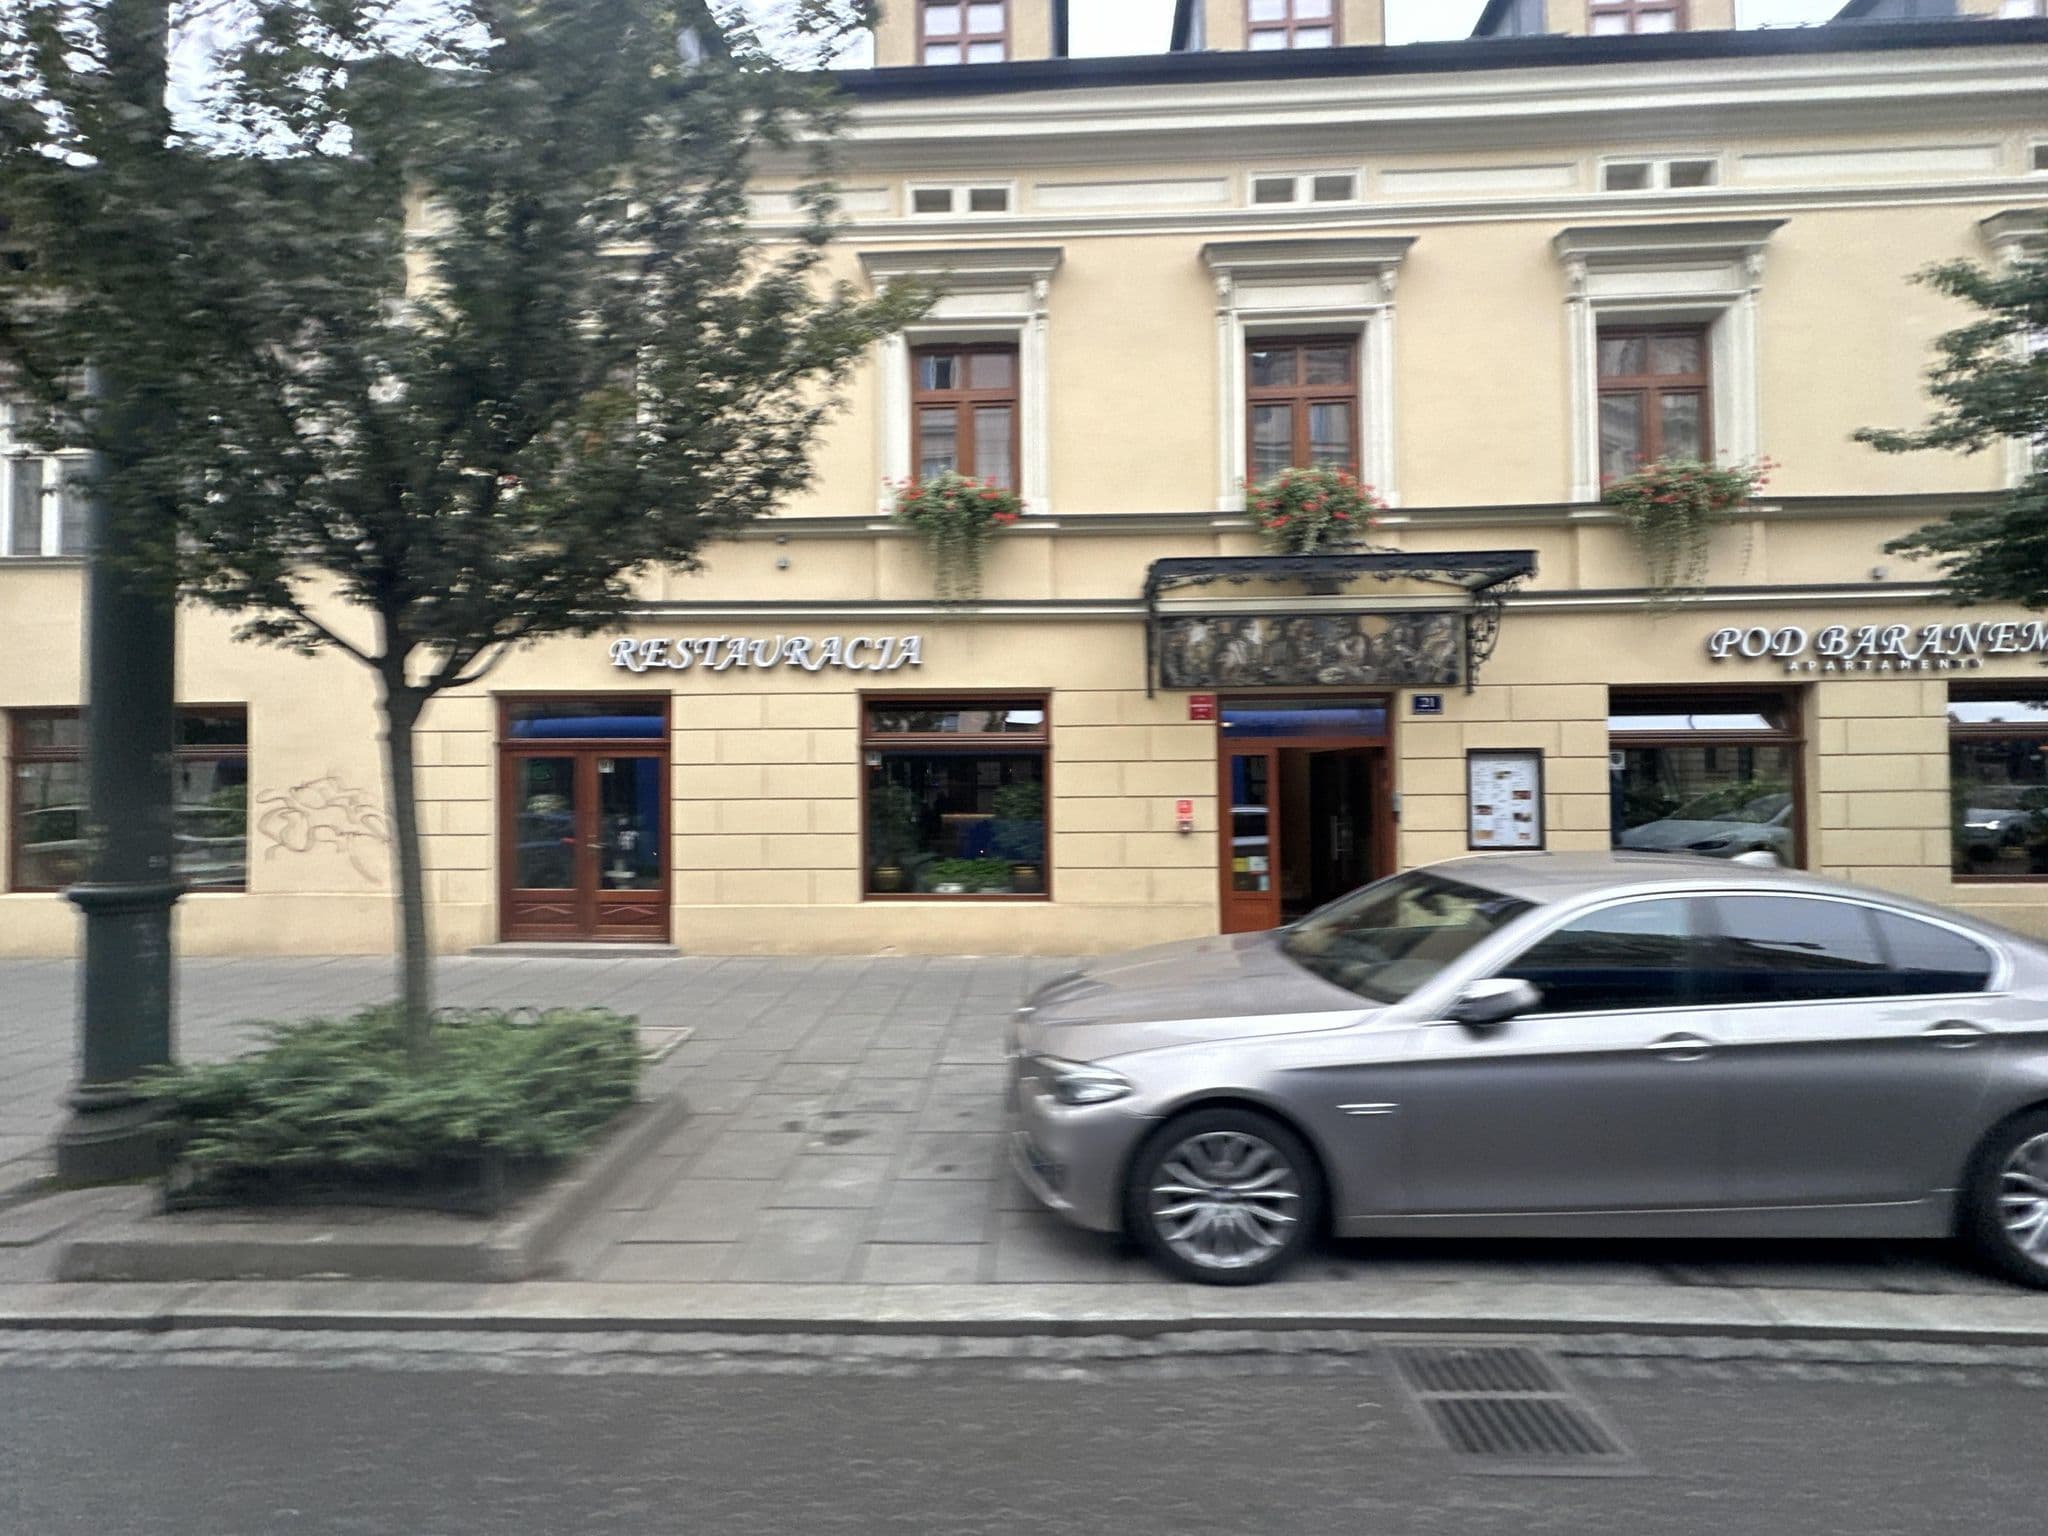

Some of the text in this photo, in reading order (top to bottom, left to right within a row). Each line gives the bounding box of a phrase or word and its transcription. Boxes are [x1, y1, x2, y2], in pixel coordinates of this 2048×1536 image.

[609, 635, 924, 672] RESTAURACJA
[1710, 626, 1808, 658] POD
[1789, 659, 1985, 671] APARTAMENTY
